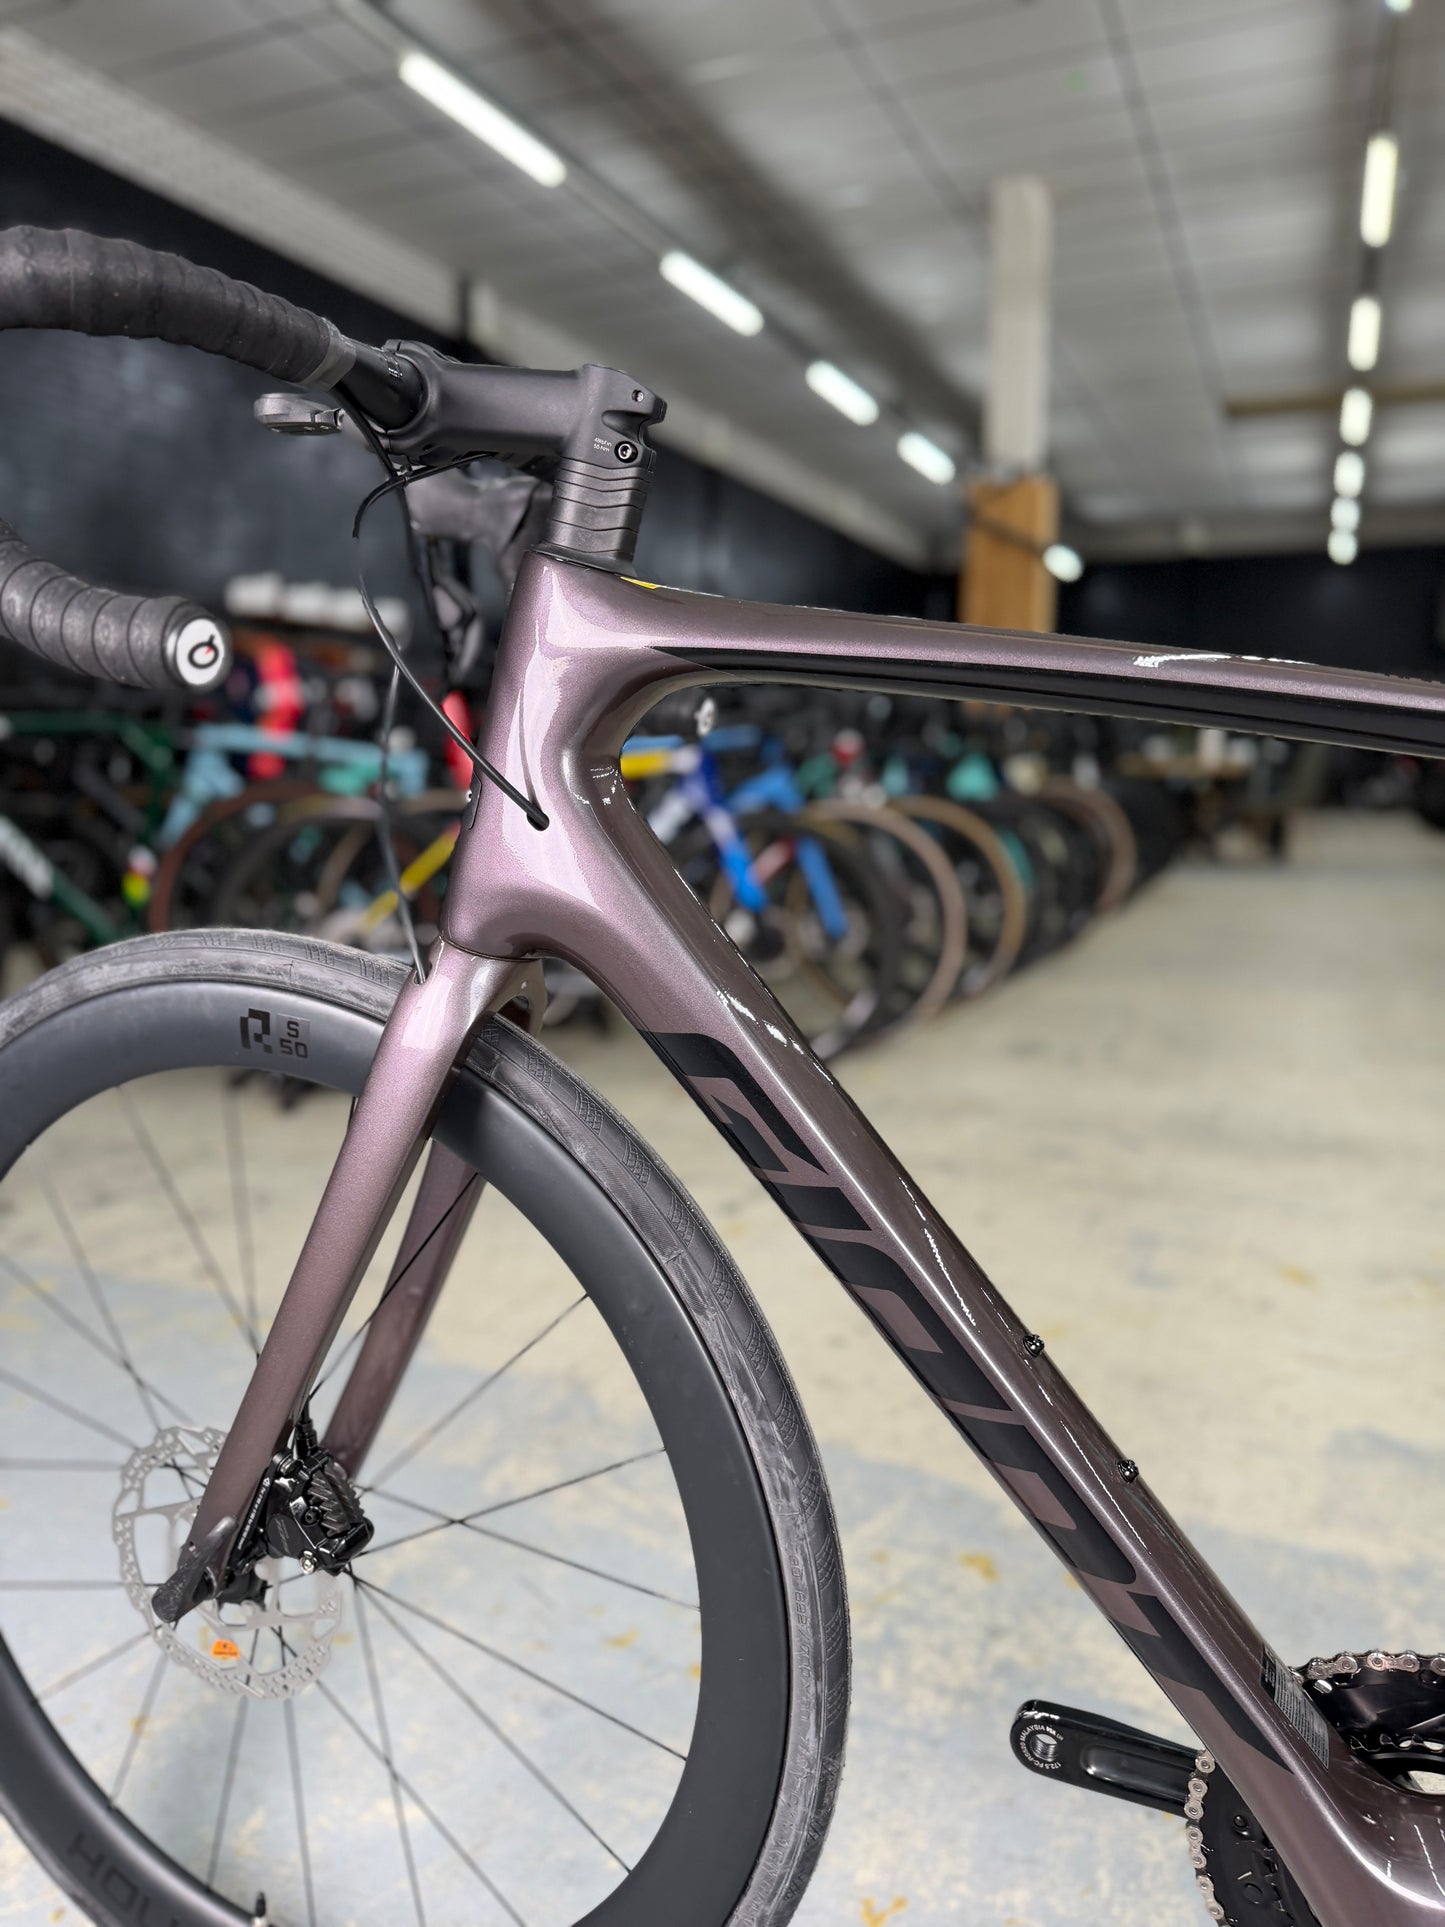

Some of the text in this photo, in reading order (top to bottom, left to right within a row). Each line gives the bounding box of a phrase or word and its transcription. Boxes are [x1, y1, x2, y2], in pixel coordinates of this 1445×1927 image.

[286, 1020, 299, 1039] S
[279, 1038, 308, 1059] 50
[638, 1030, 1295, 1774] GIANT
[1020, 1724, 1046, 1741] MALAYSIA
